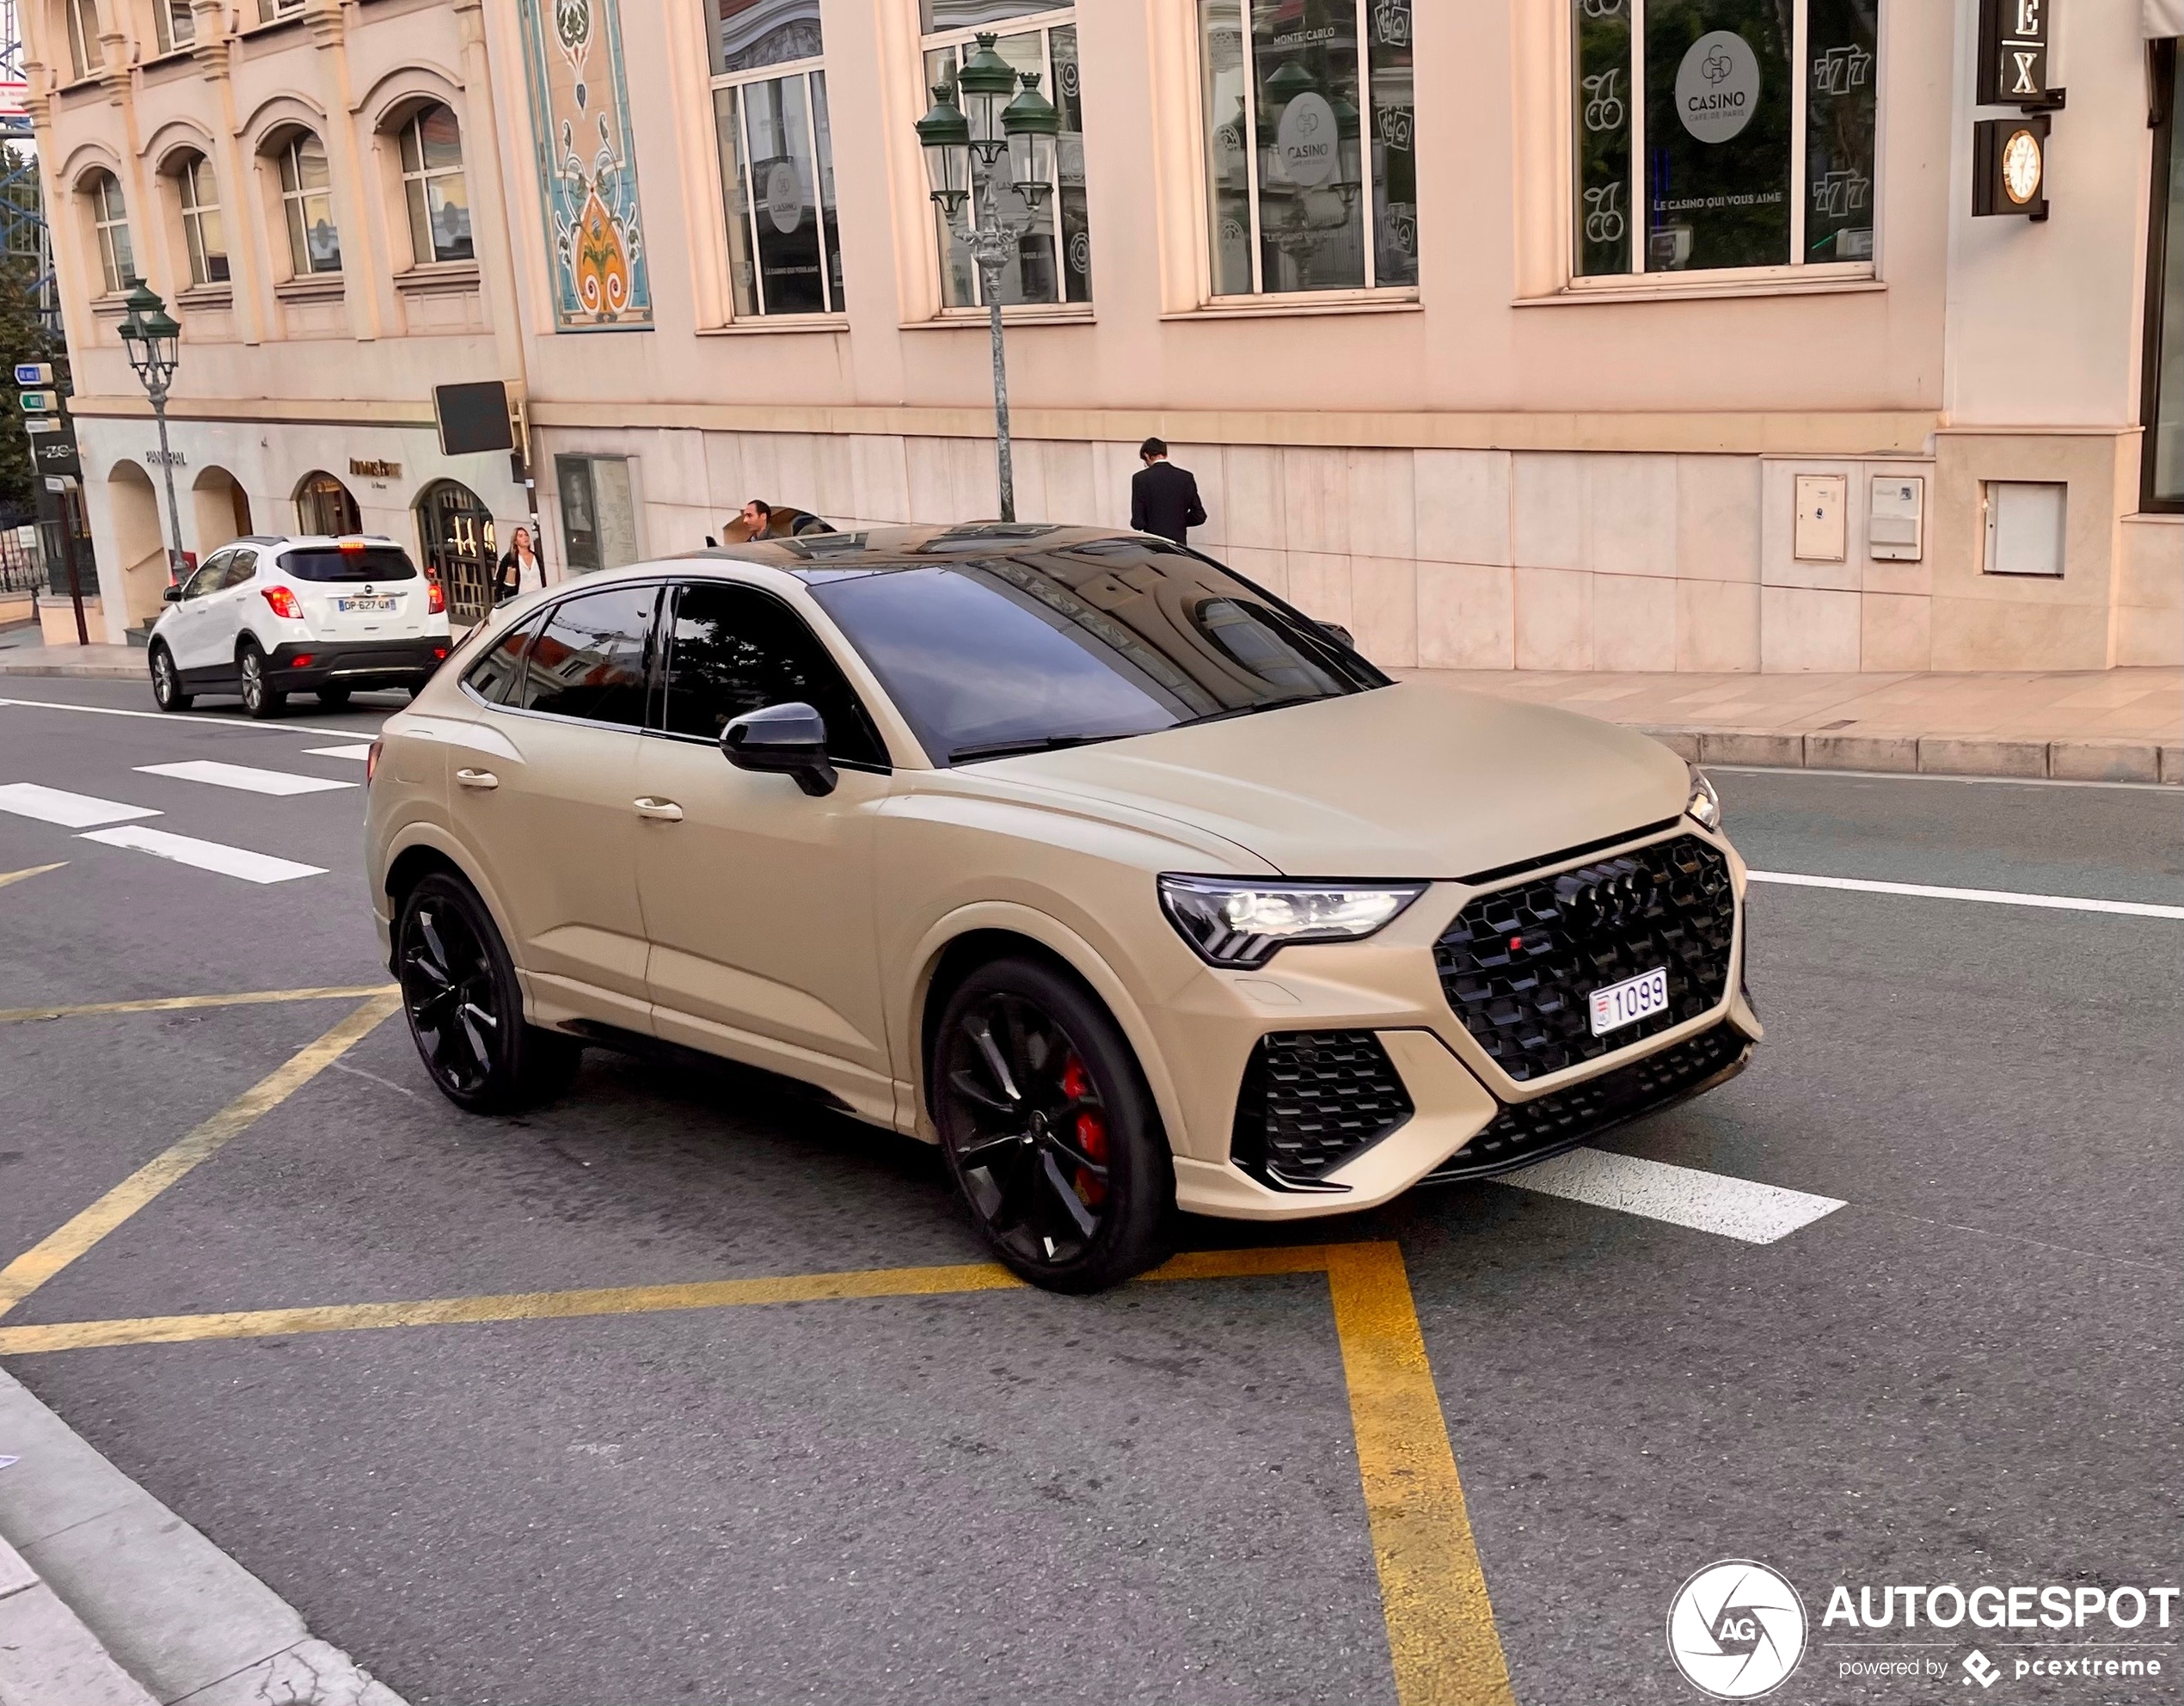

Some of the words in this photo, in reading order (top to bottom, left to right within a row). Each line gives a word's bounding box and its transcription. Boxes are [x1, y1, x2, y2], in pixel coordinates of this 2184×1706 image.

[1273, 31, 1304, 46] MONTE
[1306, 27, 1335, 40] CARLO
[1688, 91, 1745, 112] CASINO
[1710, 111, 1721, 120] DE
[1287, 143, 1328, 160] CASINO
[1653, 199, 1666, 212] LE
[1668, 197, 1704, 210] CASINO
[1706, 195, 1725, 209] QUI
[1727, 193, 1754, 206] VOUS
[1756, 191, 1782, 204] AIME
[1616, 977, 1664, 1021] 1099
